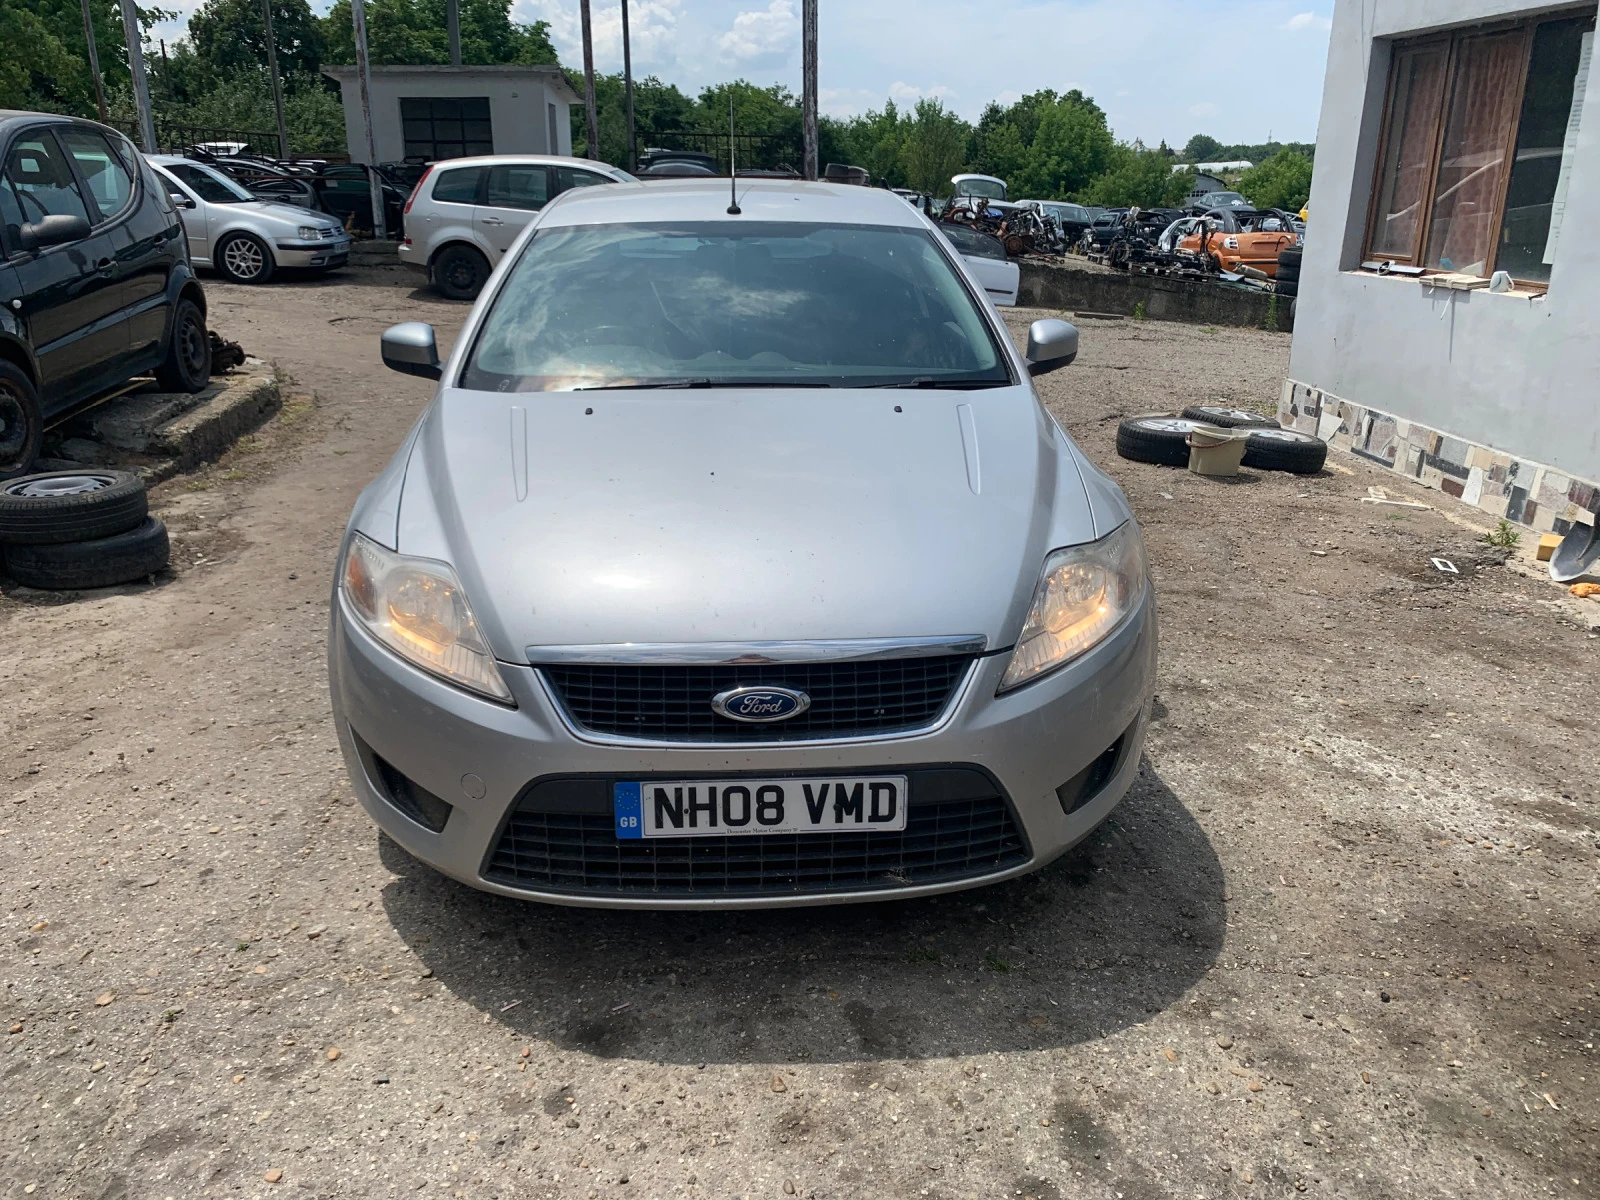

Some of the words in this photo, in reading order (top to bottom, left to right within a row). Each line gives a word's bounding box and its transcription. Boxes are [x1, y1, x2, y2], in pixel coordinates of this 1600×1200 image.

[740, 695, 782, 714] Ford
[654, 785, 785, 829] NH08
[802, 782, 897, 824] VMD
[620, 816, 637, 828] GB
